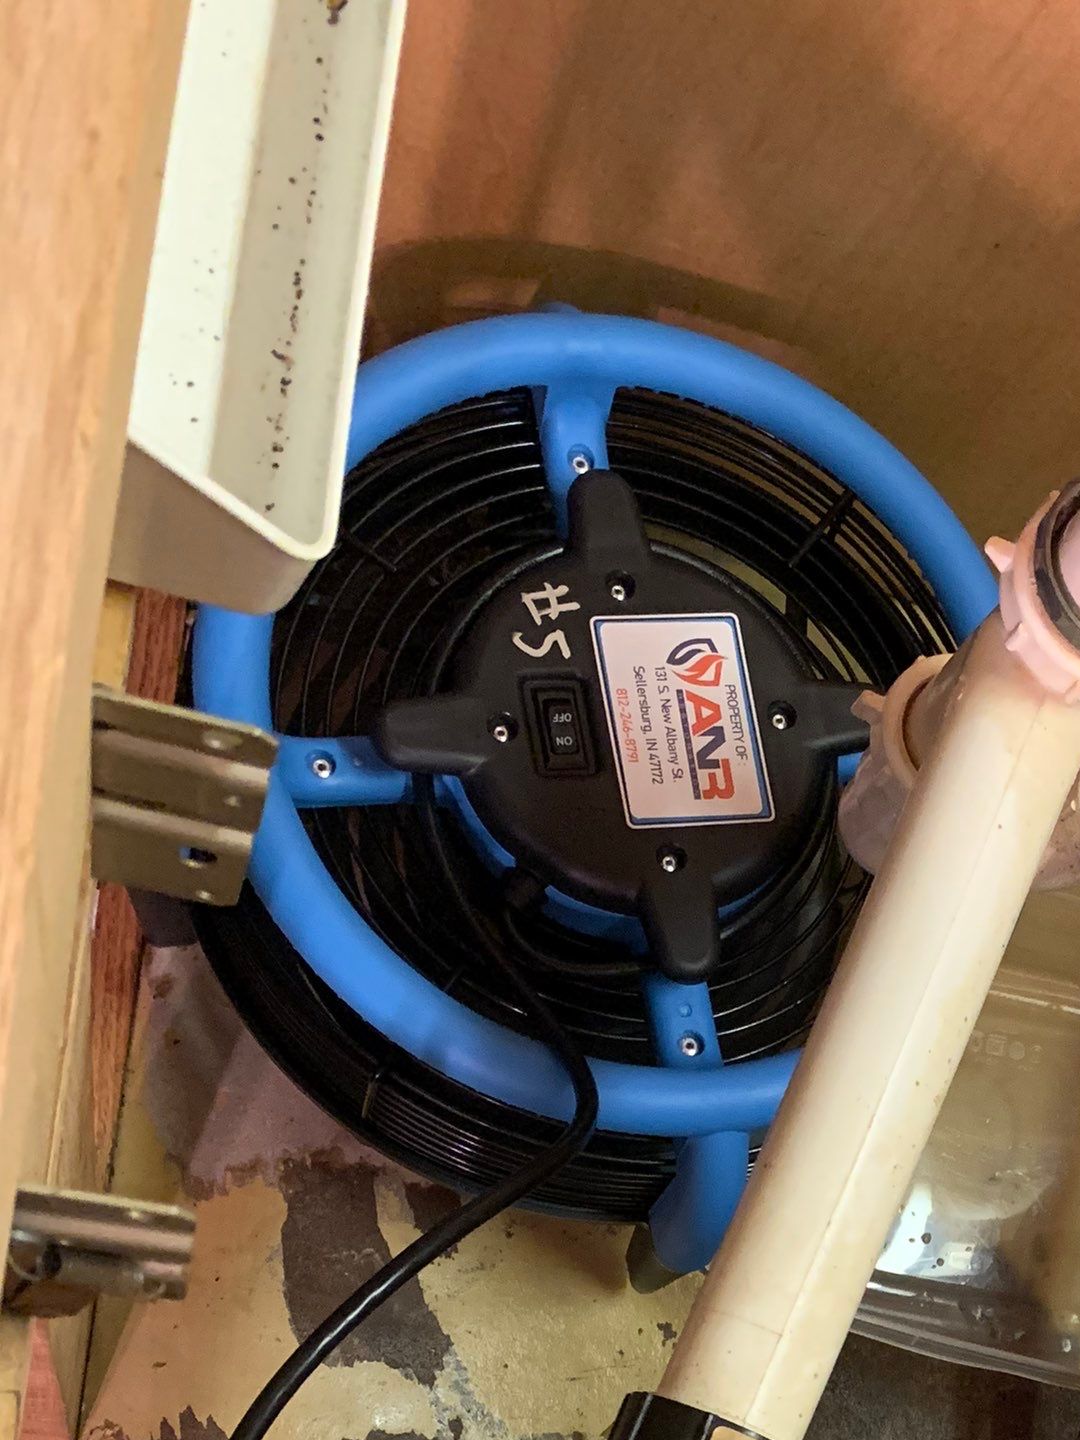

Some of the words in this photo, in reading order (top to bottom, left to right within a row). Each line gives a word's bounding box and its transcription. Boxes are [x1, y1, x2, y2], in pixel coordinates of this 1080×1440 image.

[512, 582, 581, 660] #5
[655, 666, 668, 682] 131
[633, 666, 652, 735] Sellersburg,
[660, 698, 673, 724] New
[724, 684, 745, 743] PROPERTY
[553, 712, 572, 723] OFF
[616, 688, 639, 763] 812-246-8791
[555, 736, 573, 746] ON
[645, 738, 658, 751] IN
[665, 726, 679, 766] Albany
[685, 689, 735, 800] ANR
[649, 753, 664, 785] 47172
[672, 768, 684, 783] St.
